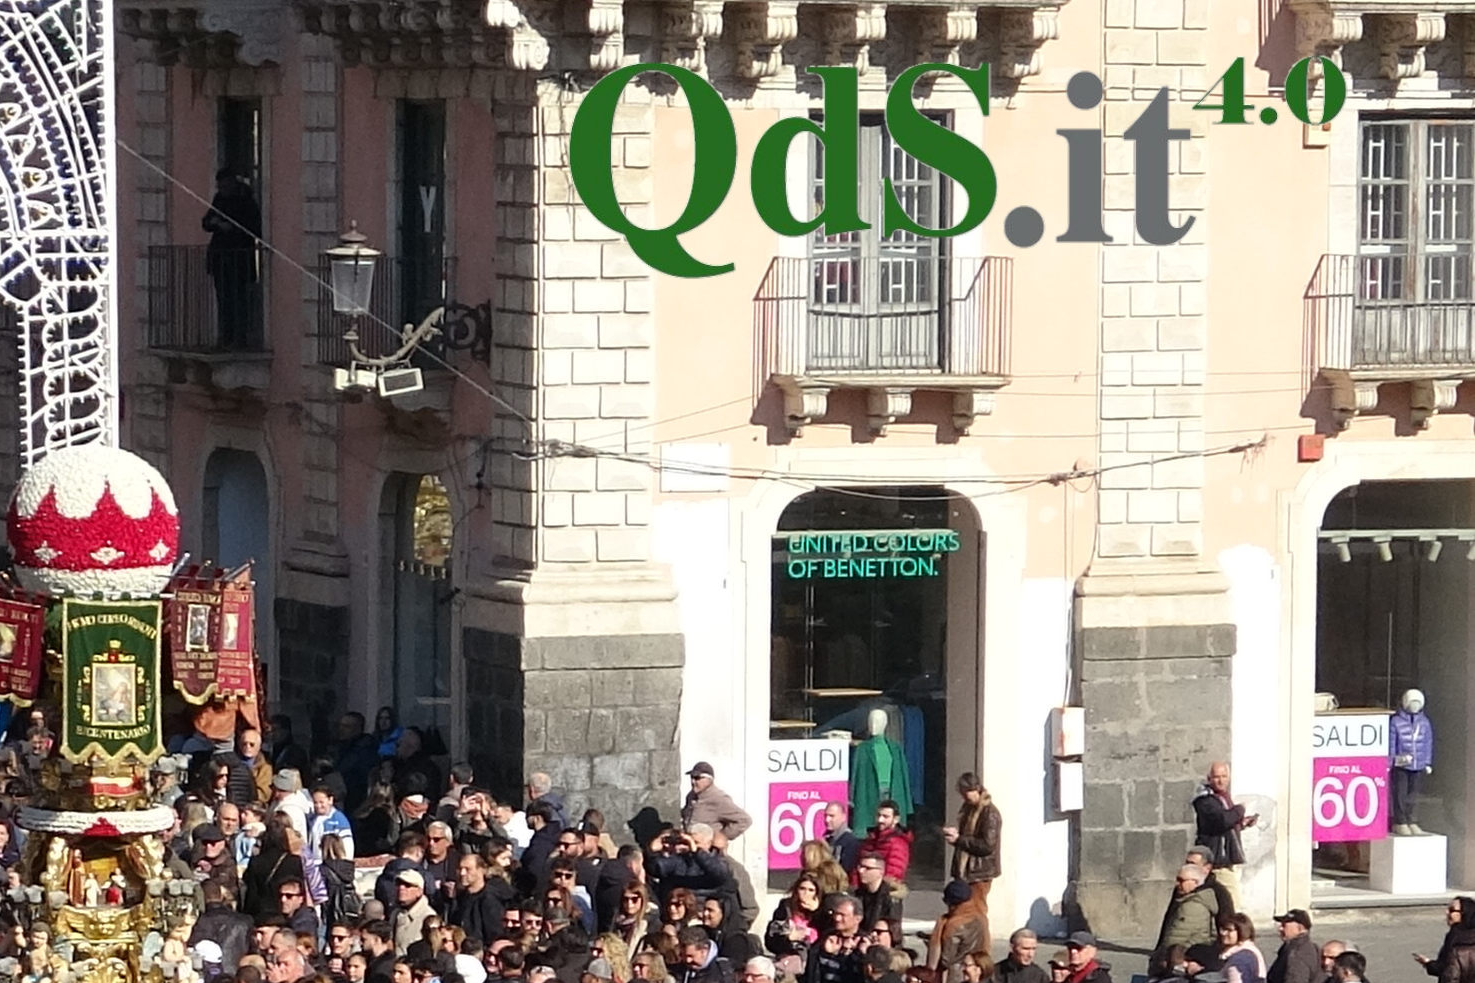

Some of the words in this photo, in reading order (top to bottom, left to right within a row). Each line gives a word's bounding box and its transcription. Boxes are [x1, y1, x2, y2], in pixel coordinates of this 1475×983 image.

[789, 534, 869, 553] UNITED
[873, 532, 960, 552] COLORS
[788, 559, 818, 578] OF
[823, 556, 938, 577] BENETTON.
[1312, 723, 1383, 748] SALDI
[767, 748, 842, 772] SALDI
[1329, 765, 1349, 774] FINO
[1351, 765, 1362, 774] AL
[787, 791, 809, 800] FINO
[809, 791, 821, 800] AL
